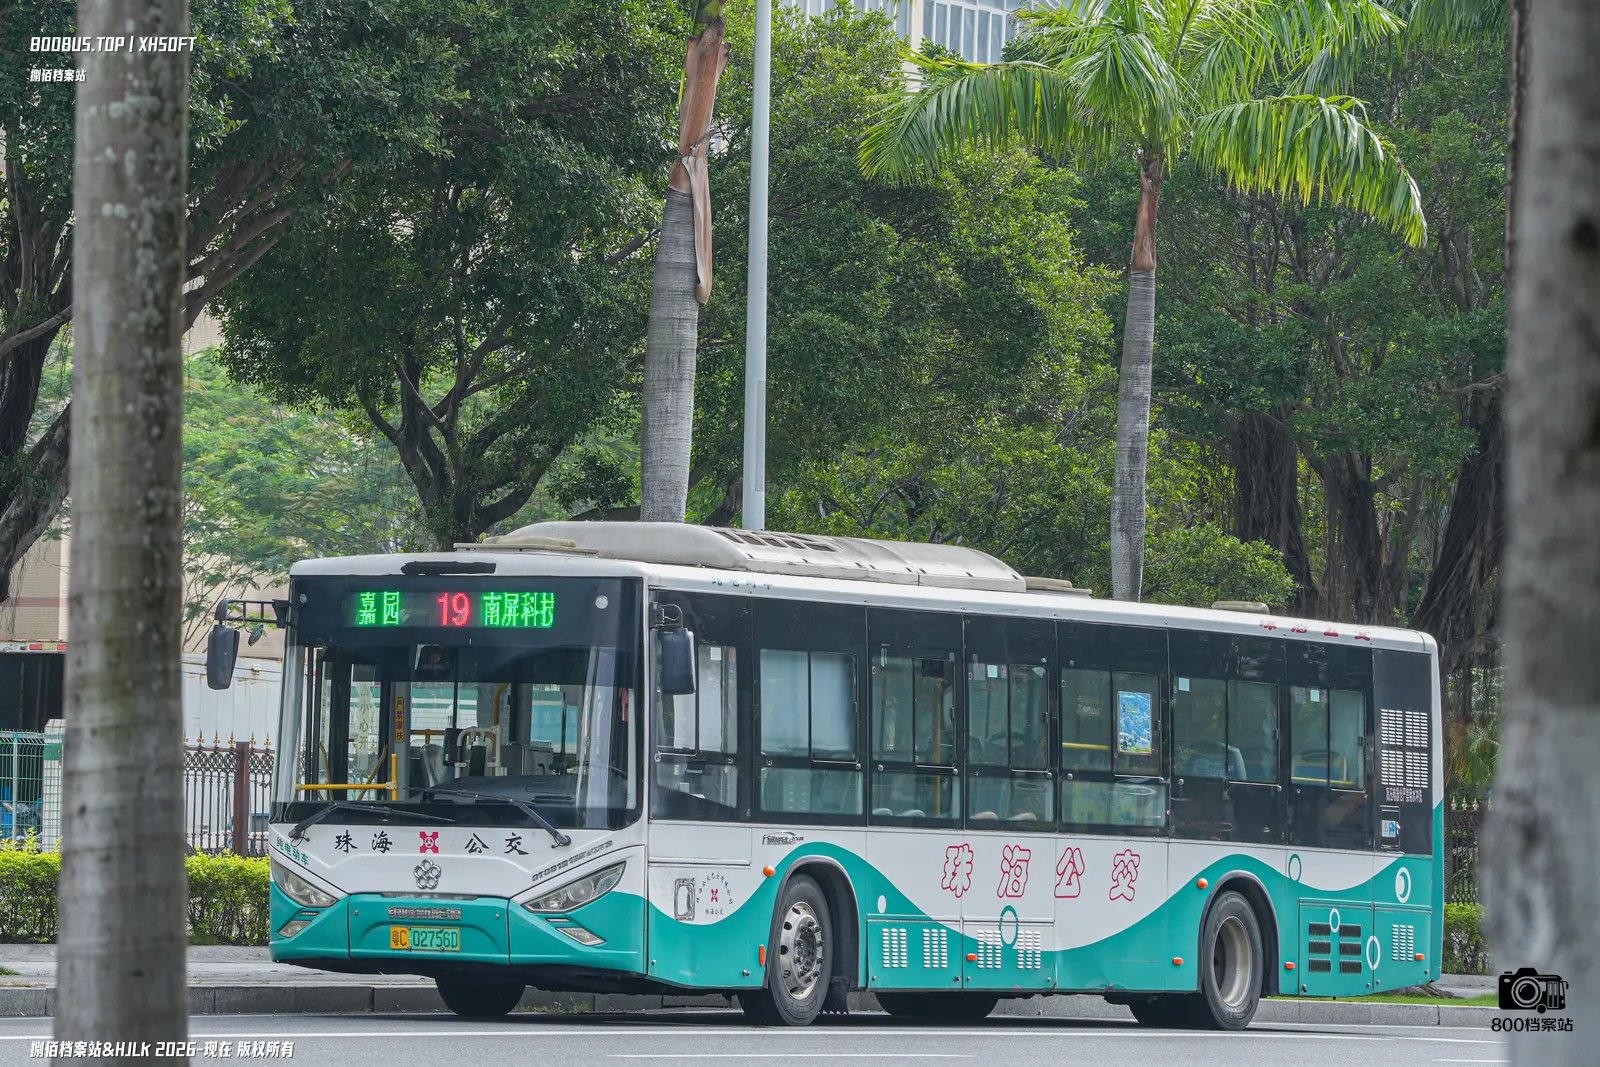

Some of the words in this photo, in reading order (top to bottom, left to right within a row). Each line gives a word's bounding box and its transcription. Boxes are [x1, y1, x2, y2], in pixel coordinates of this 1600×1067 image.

[358, 591, 400, 625] 嘉园
[437, 592, 470, 626] 19
[482, 591, 555, 627] 南屏科技
[276, 836, 309, 866] 纯电动车
[334, 829, 393, 854] 珠海
[464, 831, 530, 855] 公交
[941, 843, 1140, 901] 珠海公交
